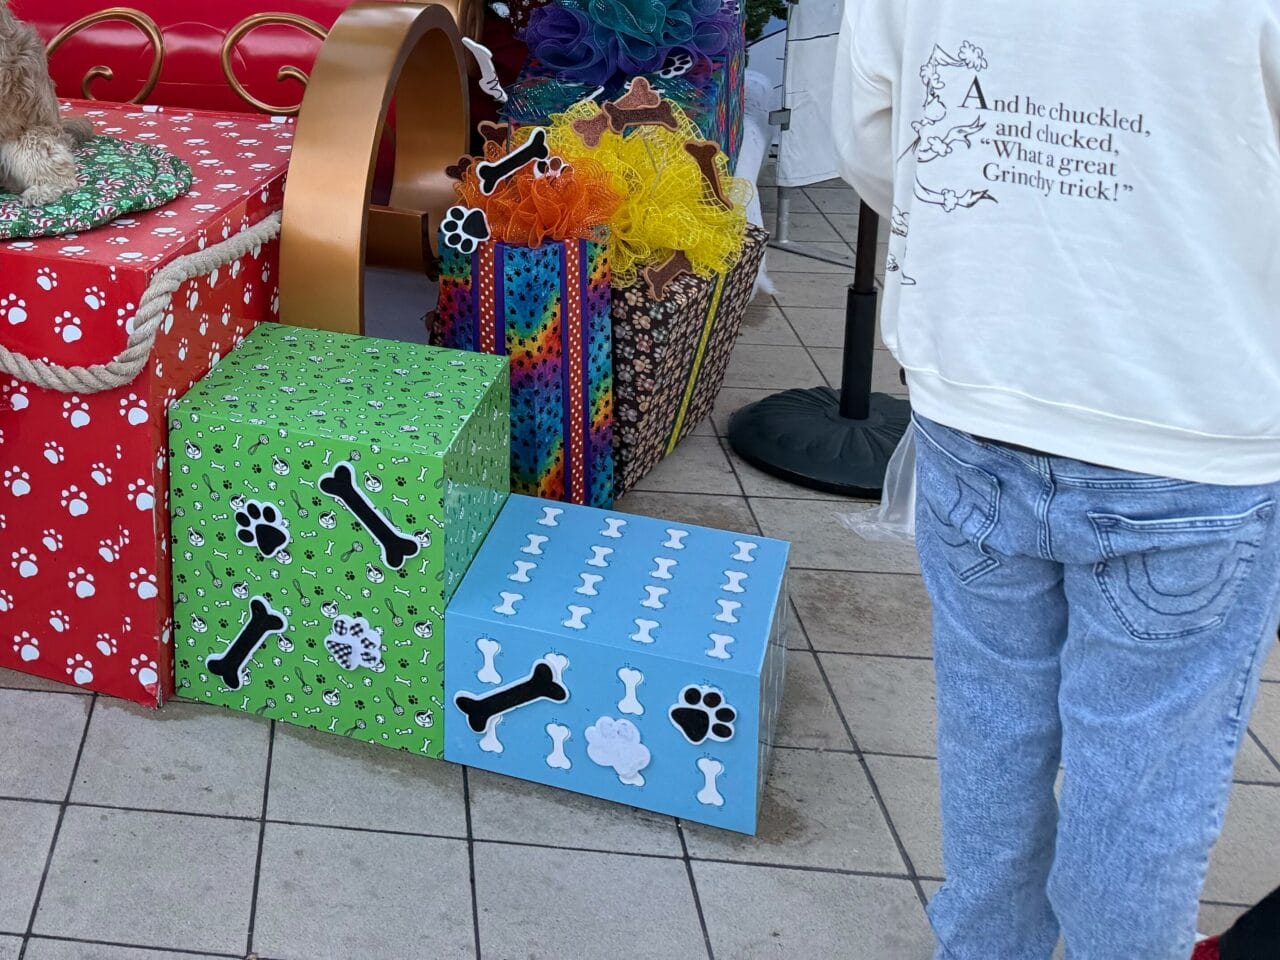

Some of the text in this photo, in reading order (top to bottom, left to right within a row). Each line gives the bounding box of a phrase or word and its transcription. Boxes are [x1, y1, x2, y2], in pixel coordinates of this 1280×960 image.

[957, 75, 1151, 138] And he chuckled,
[996, 121, 1120, 157] and clucked,
[982, 162, 1134, 202] Grinchy trick!”
[1046, 154, 1054, 168] a
[1058, 157, 1117, 177] great
